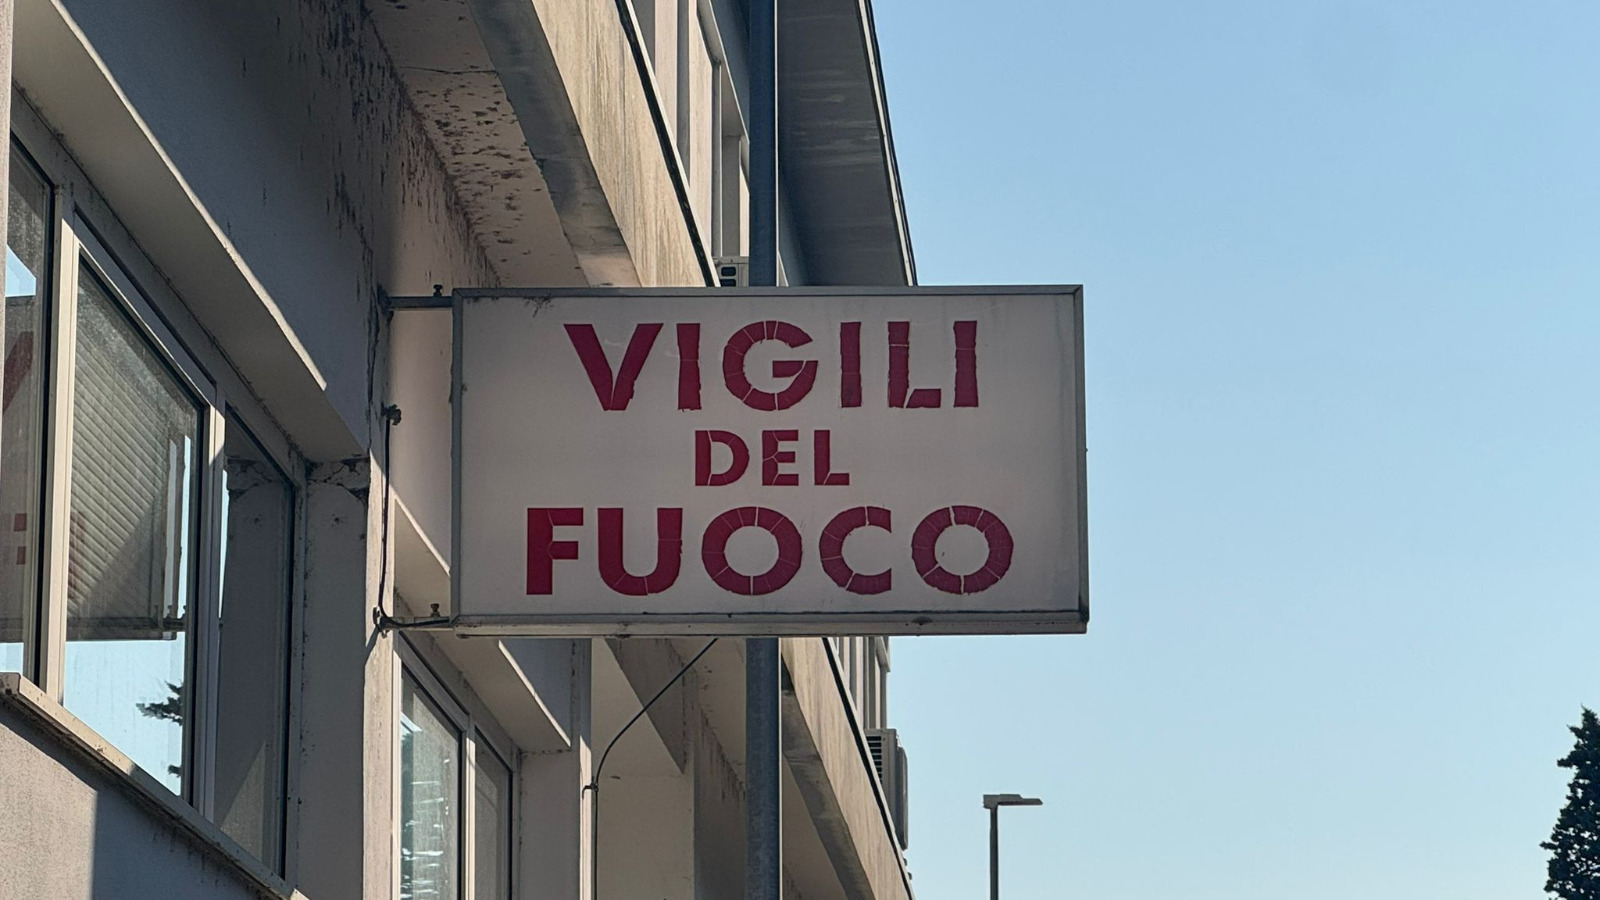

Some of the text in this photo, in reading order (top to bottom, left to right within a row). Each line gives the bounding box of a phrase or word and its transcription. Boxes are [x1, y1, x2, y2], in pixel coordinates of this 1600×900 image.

[564, 321, 978, 411] VIGILI
[695, 430, 850, 486] DEL
[526, 505, 1014, 596] FUOCO
